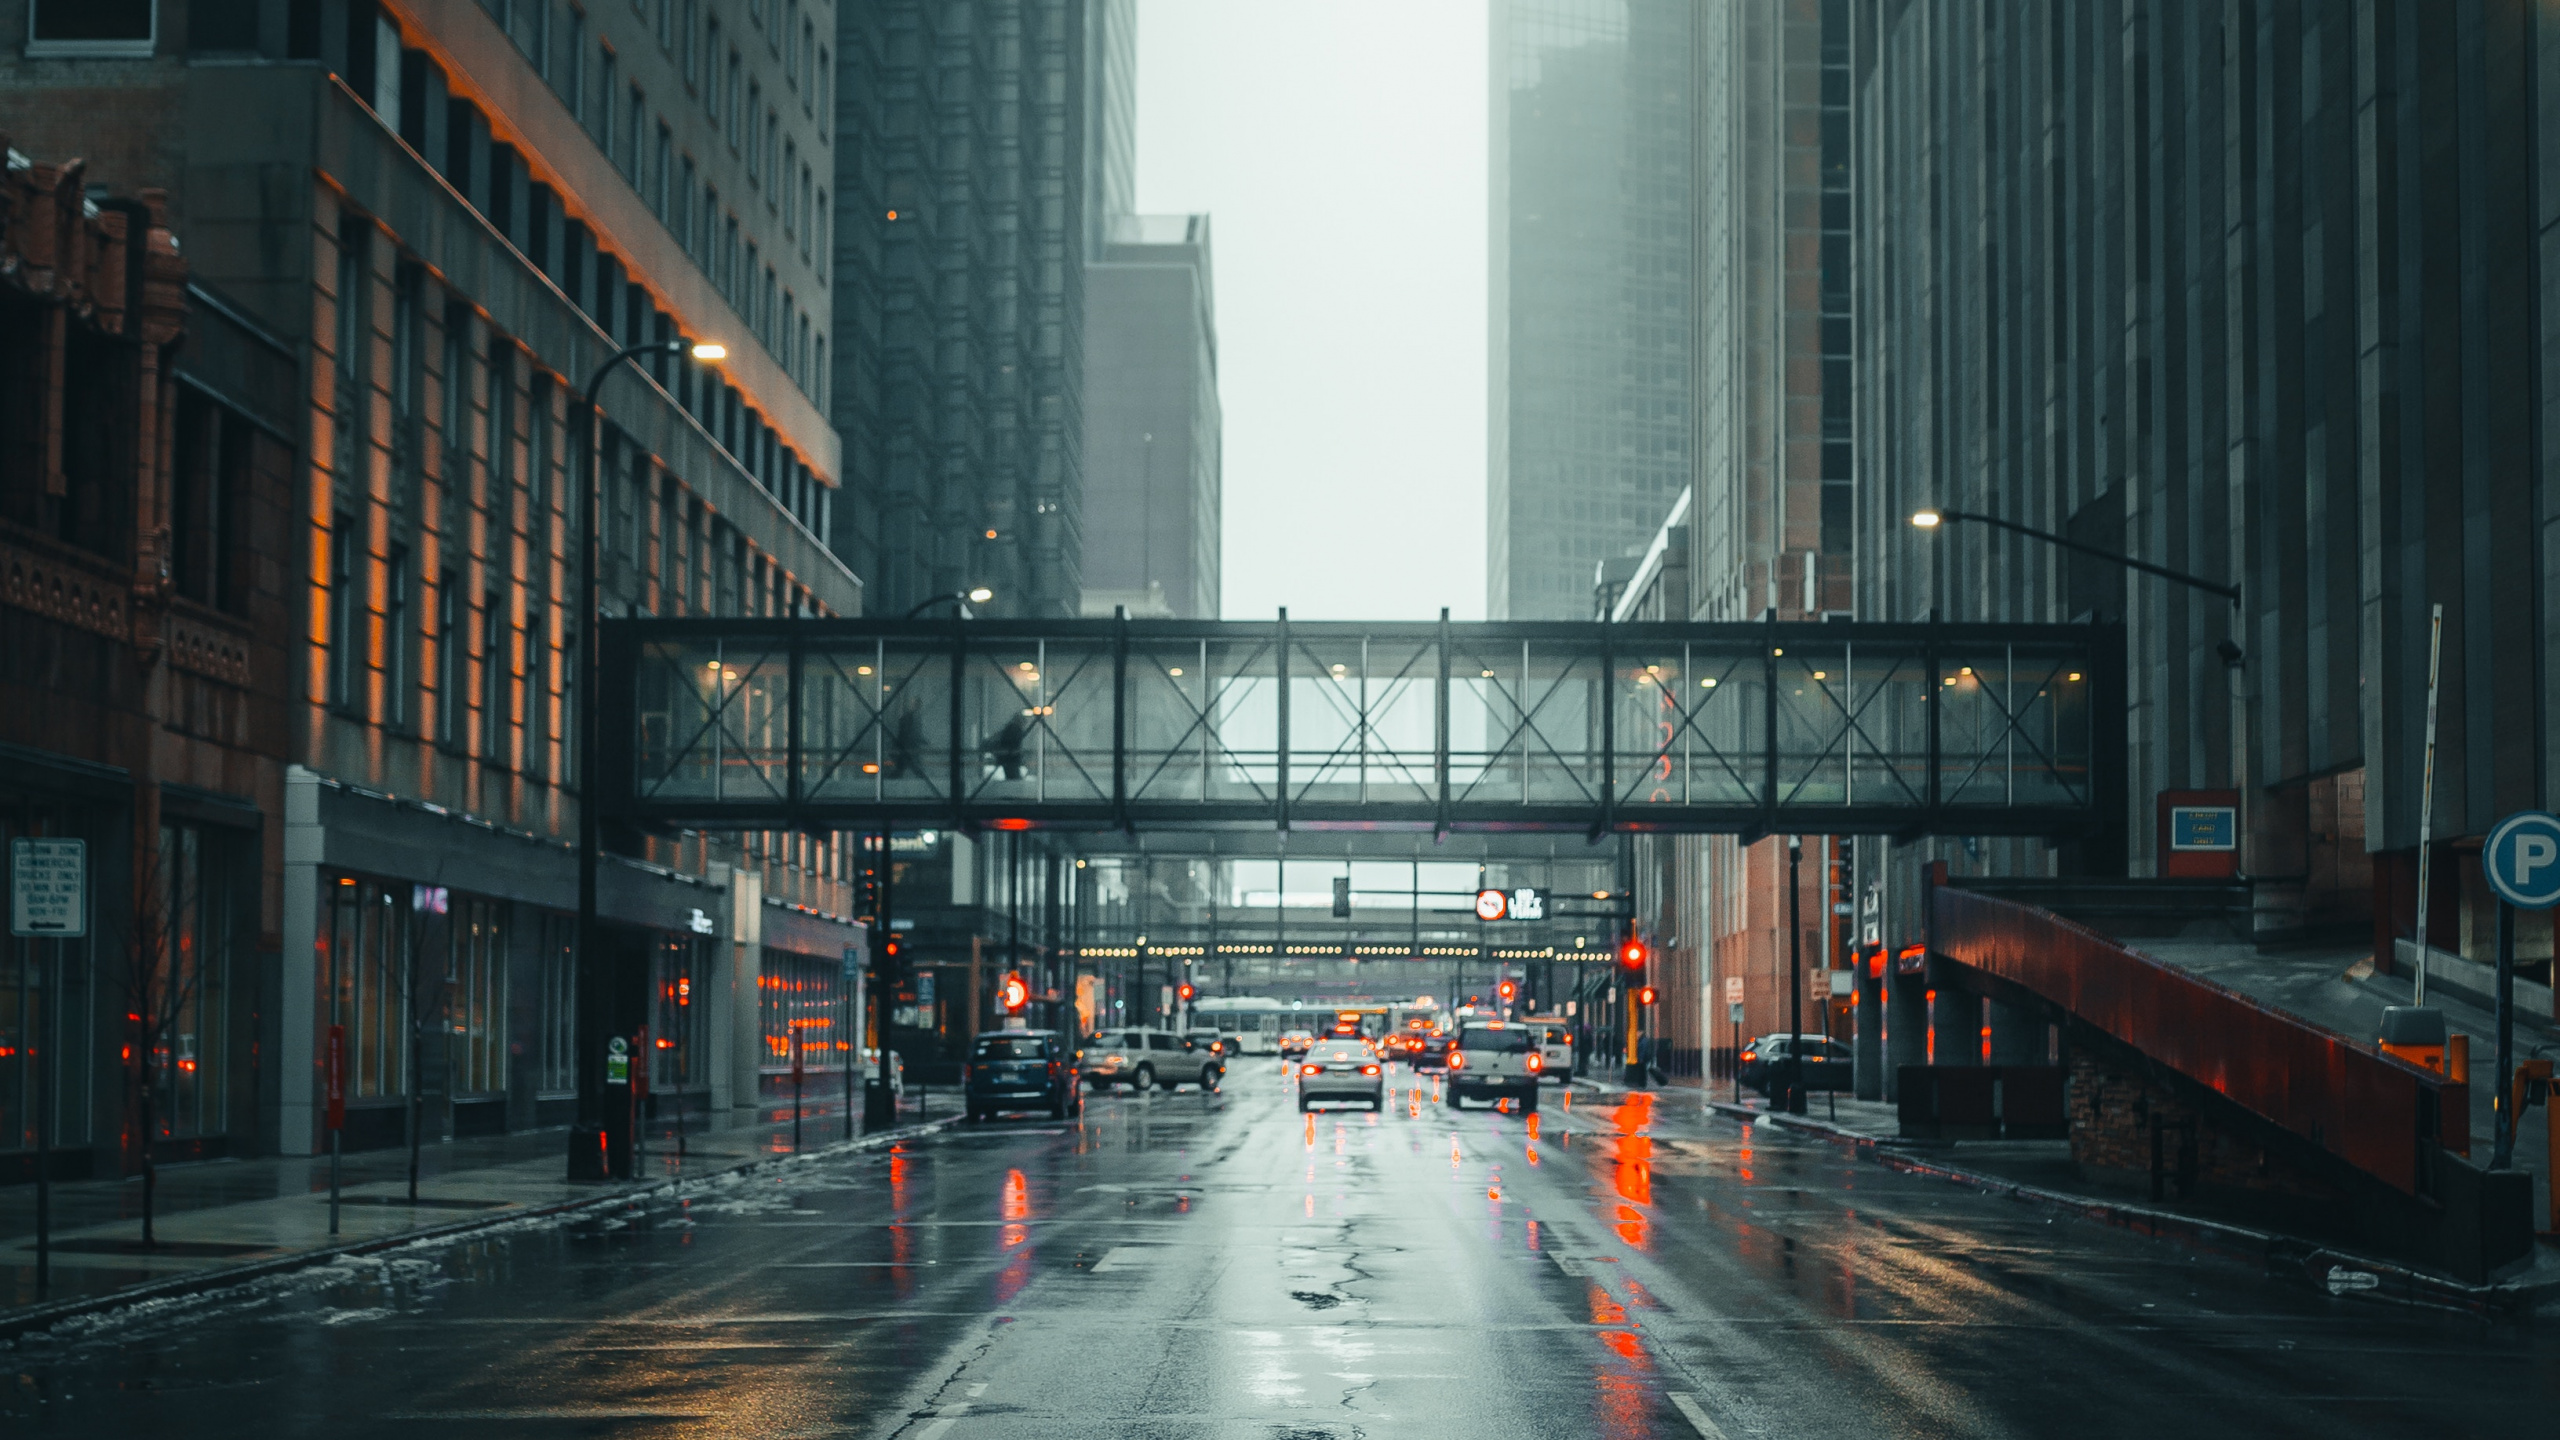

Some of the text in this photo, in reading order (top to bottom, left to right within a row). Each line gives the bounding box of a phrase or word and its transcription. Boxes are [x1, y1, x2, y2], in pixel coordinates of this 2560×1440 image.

[2192, 824, 2215, 833] CARD
[2193, 837, 2215, 845] ONLY
[19, 857, 76, 868] COMMERCIAL
[2515, 833, 2557, 885] P
